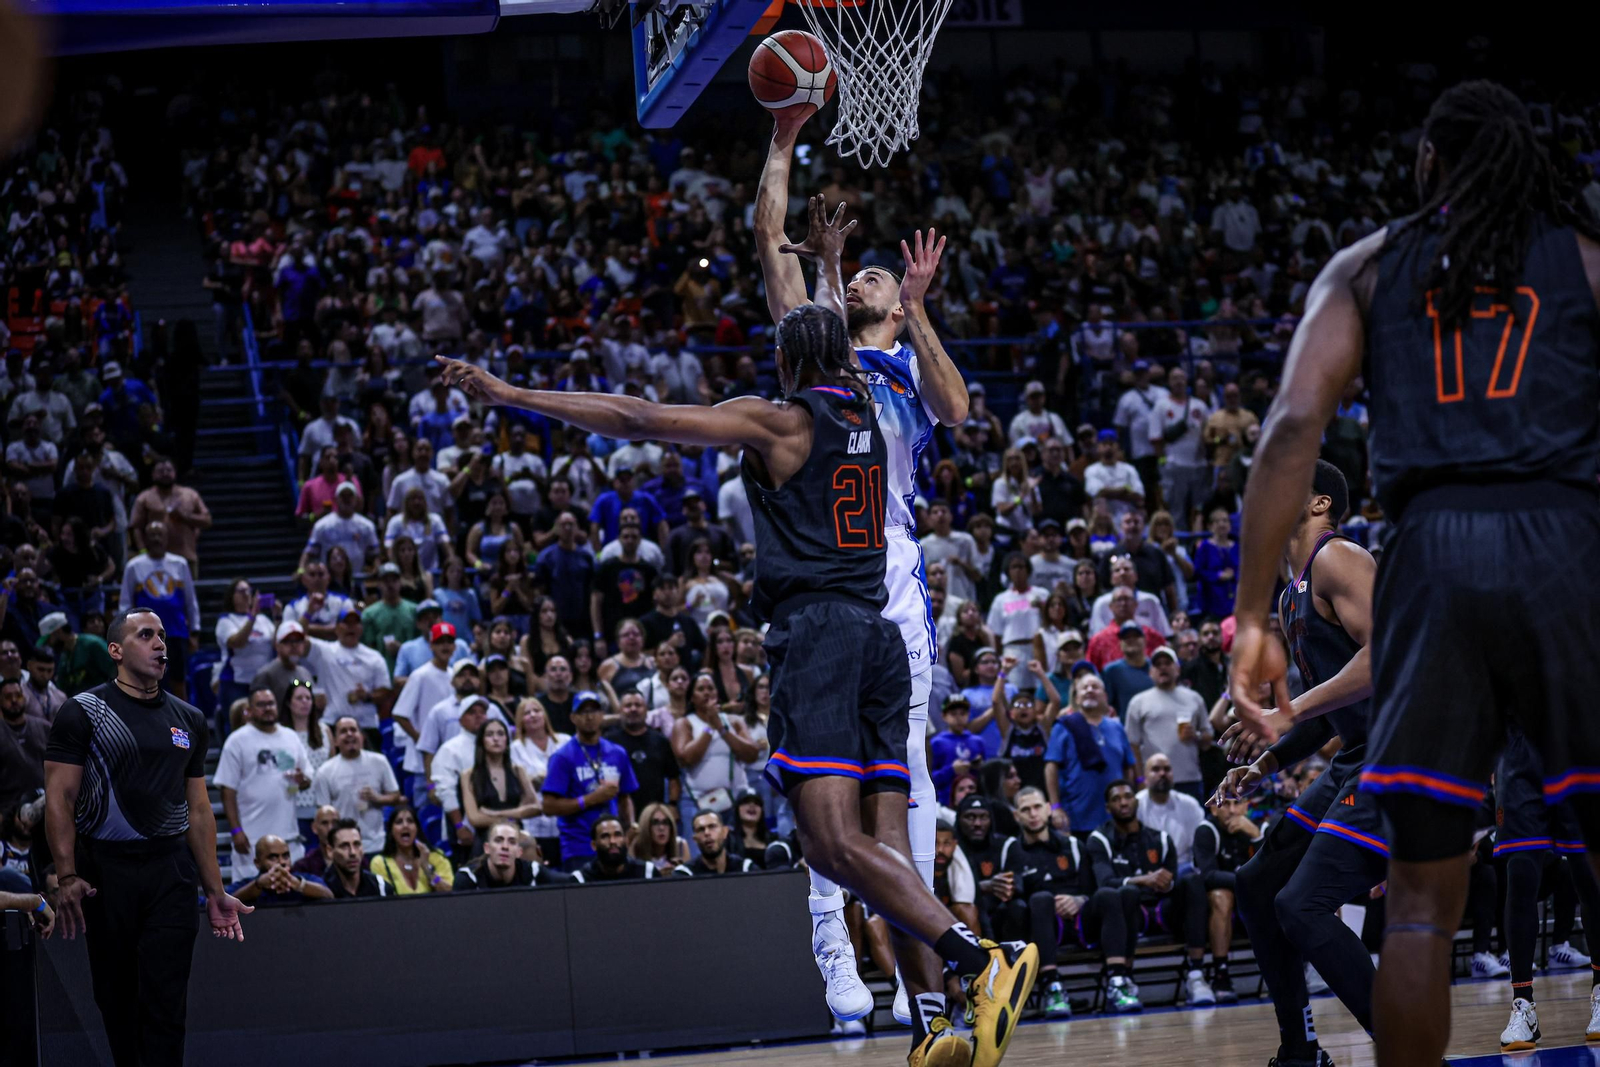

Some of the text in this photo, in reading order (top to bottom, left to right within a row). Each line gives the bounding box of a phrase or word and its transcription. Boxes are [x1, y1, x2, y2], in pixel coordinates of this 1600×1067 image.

[1425, 285, 1540, 404] 17
[847, 430, 872, 455] CLARK
[832, 464, 885, 548] 21
[907, 648, 920, 659] rty
